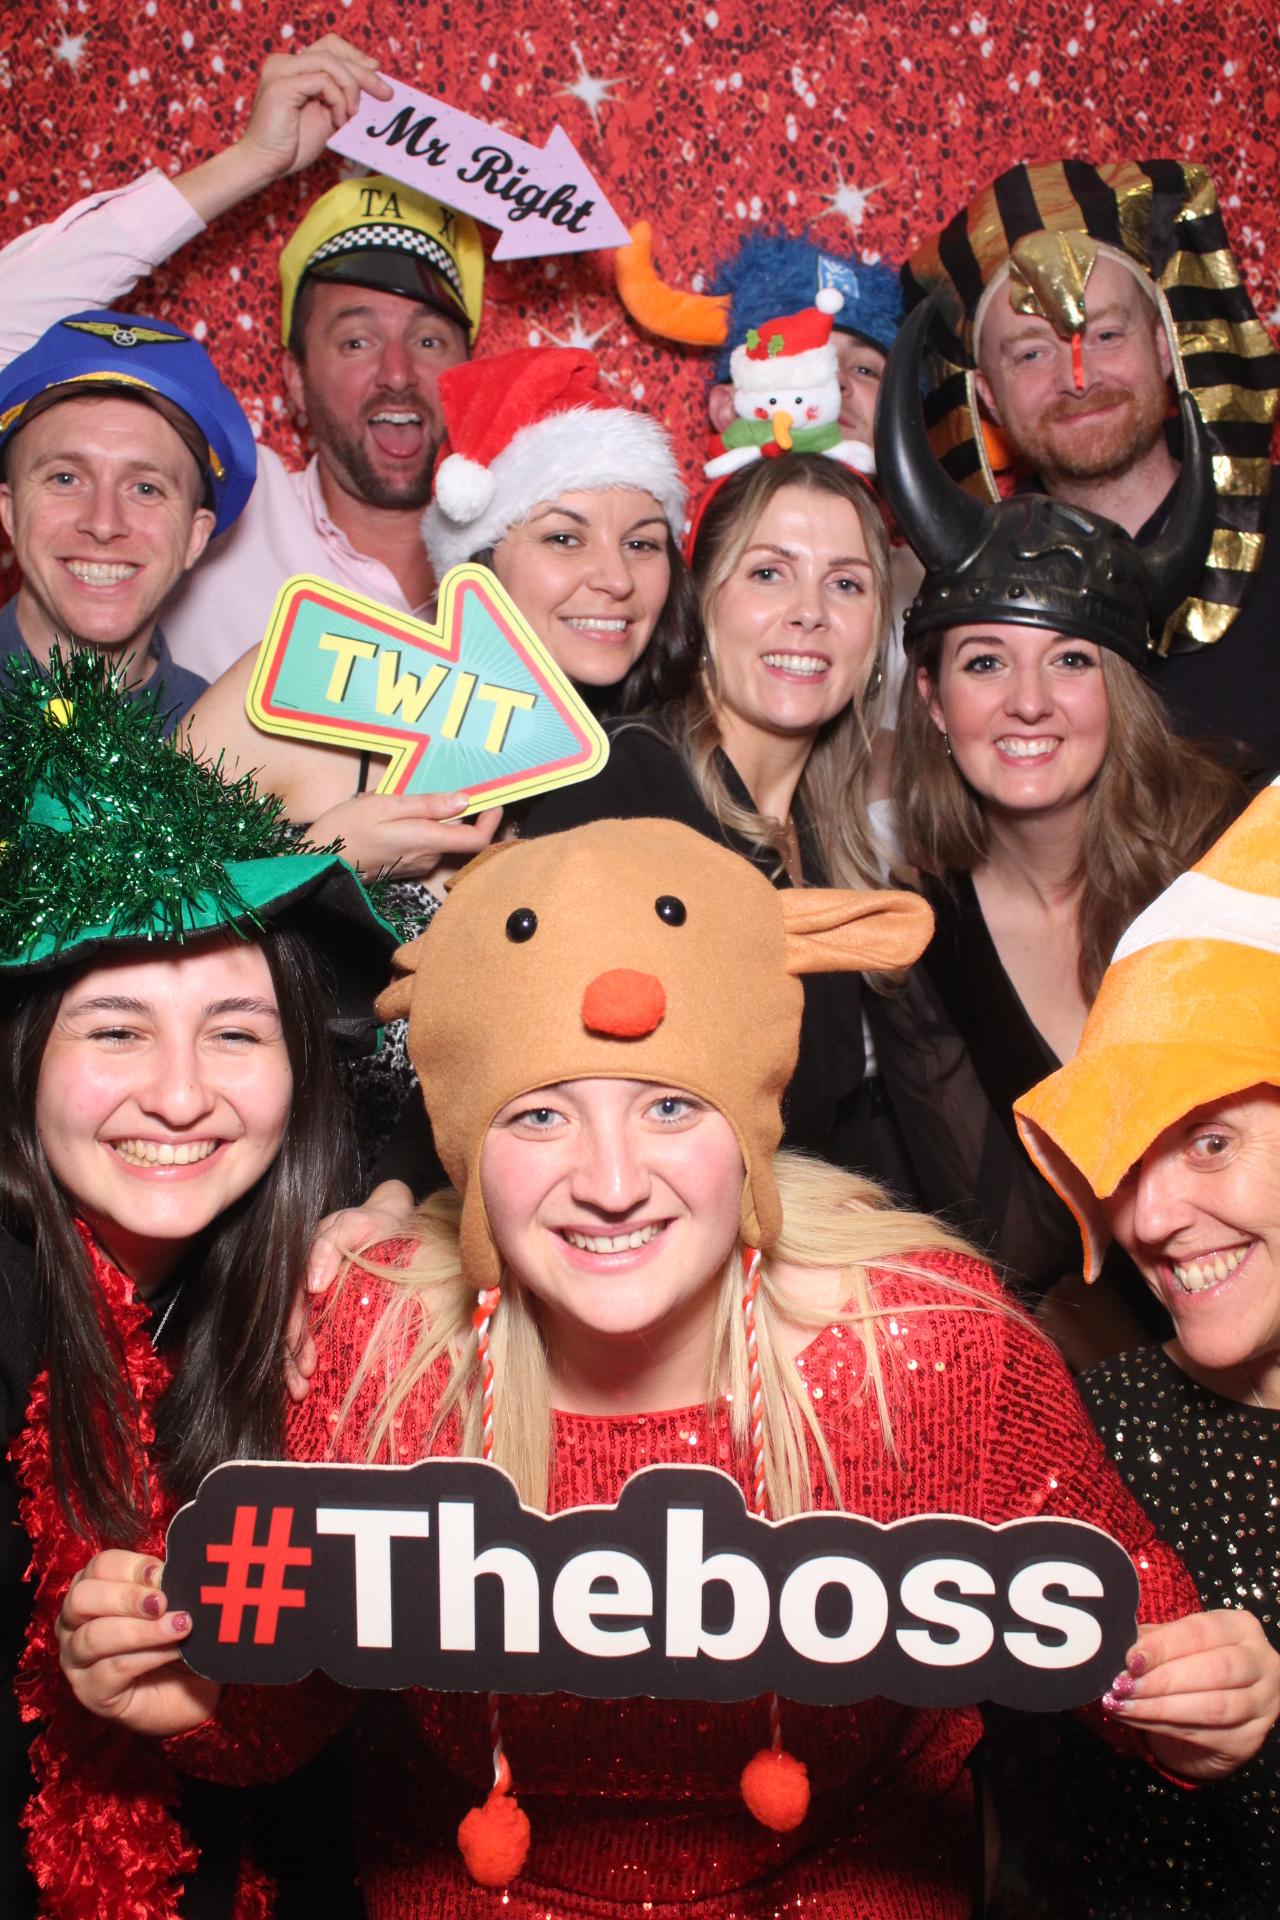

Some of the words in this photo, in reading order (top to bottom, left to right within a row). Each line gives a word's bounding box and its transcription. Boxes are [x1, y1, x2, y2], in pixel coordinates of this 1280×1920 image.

[366, 106, 450, 166] Mr
[457, 146, 595, 233] Right
[319, 632, 537, 755] TWIT
[200, 1501, 1105, 1669] #Theboss
